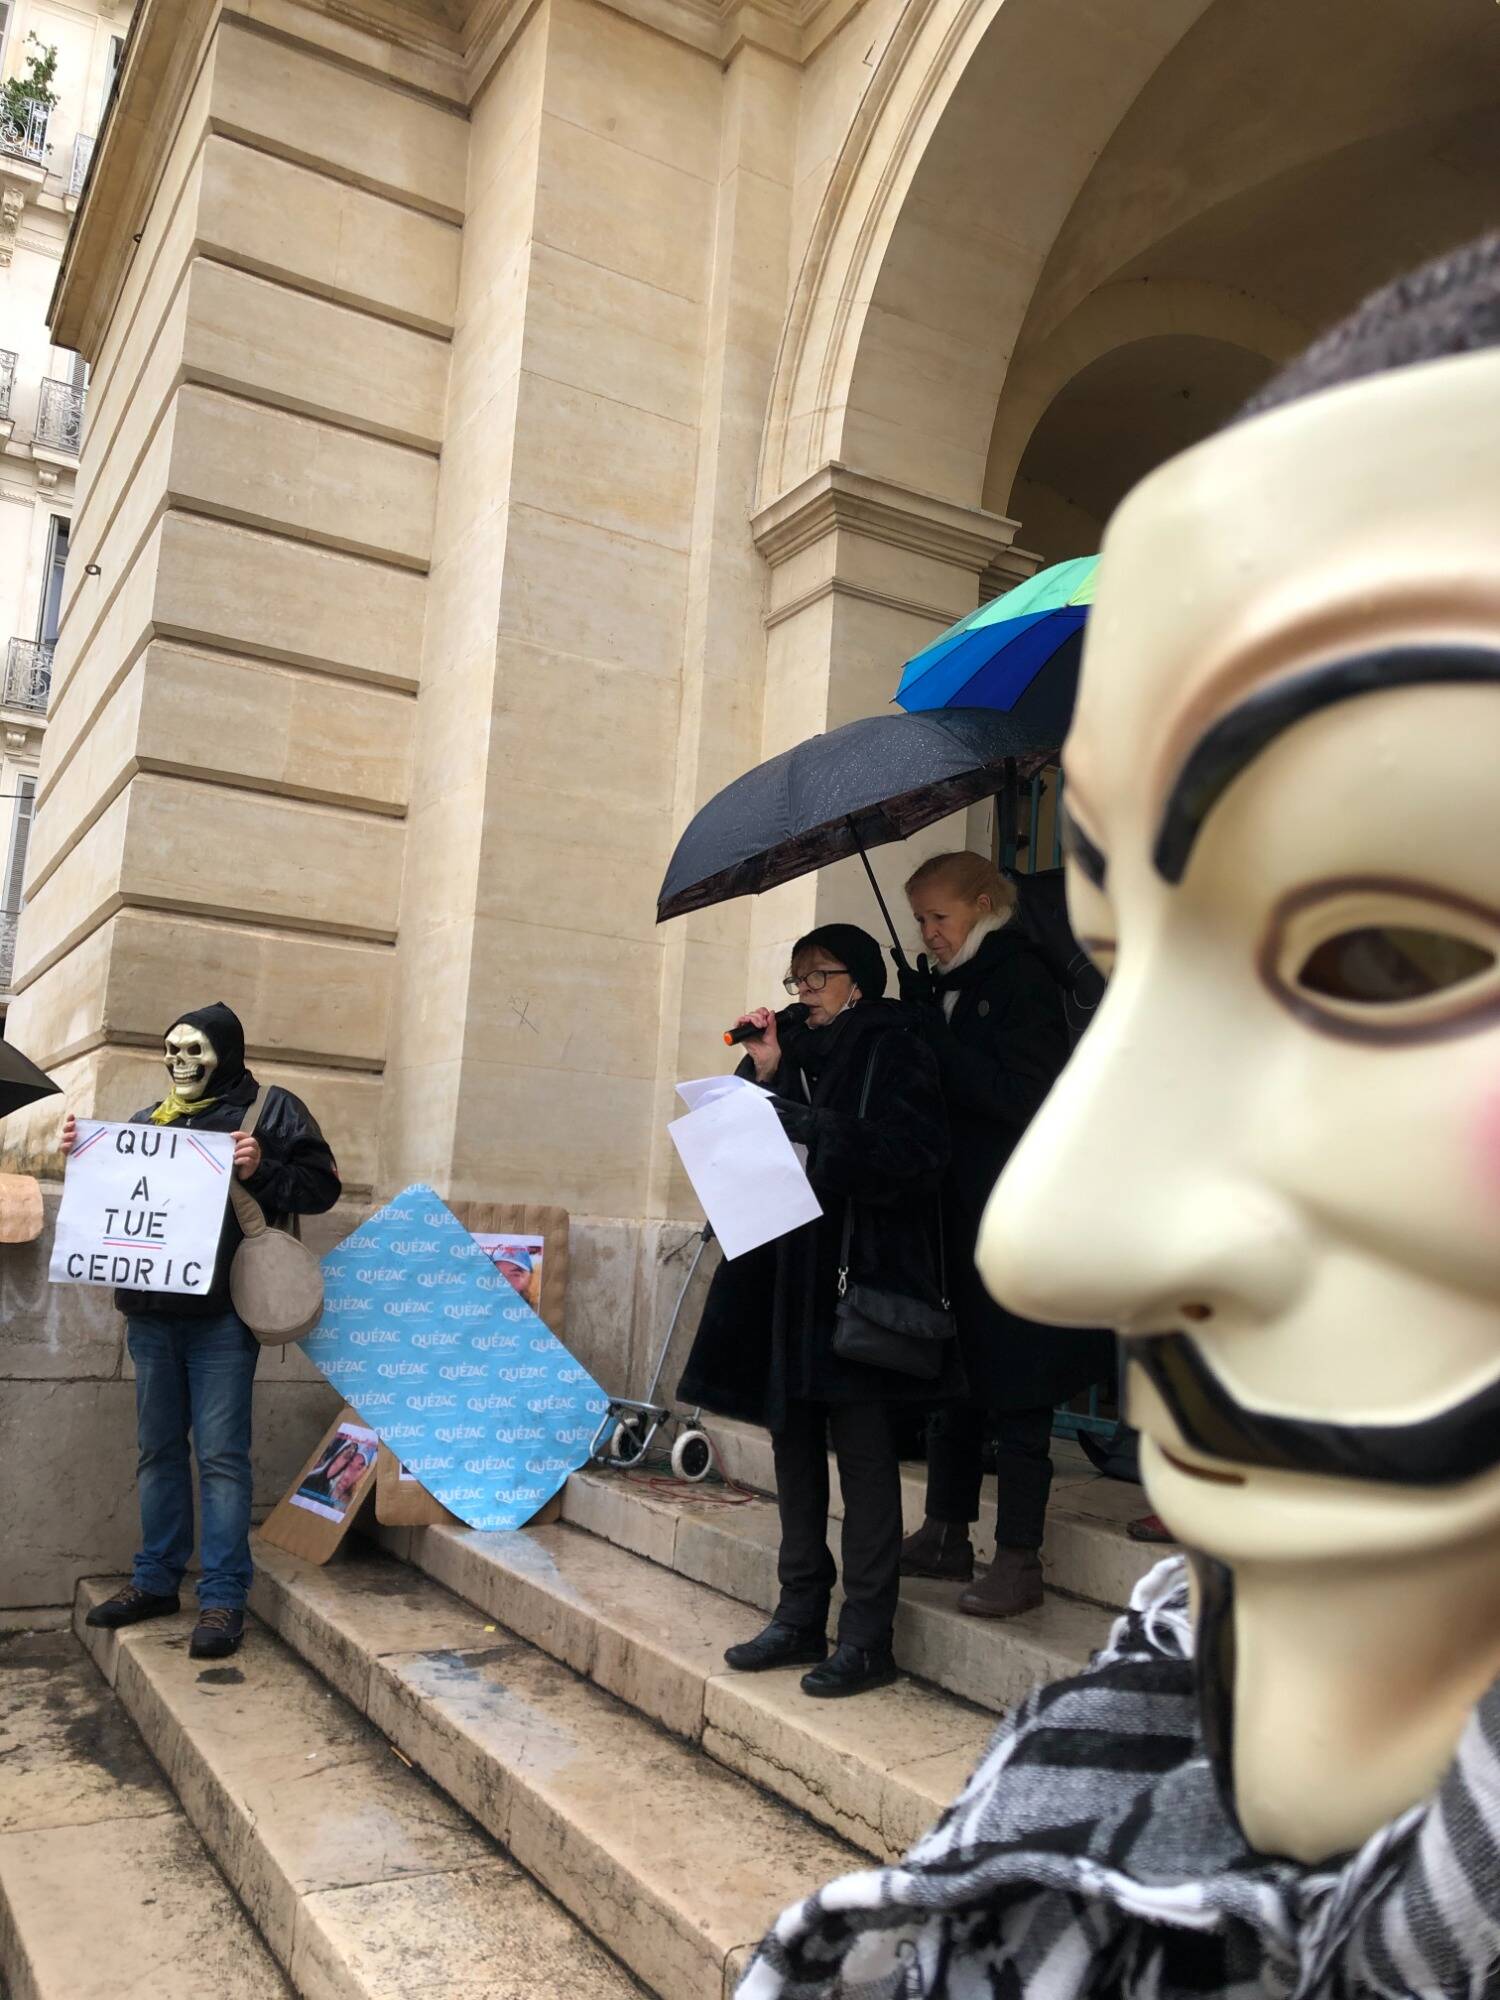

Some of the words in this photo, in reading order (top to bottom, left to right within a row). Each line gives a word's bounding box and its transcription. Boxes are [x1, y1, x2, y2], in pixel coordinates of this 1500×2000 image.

[116, 1129, 177, 1159] QUI
[130, 1176, 149, 1201] A
[390, 1238, 440, 1255] QUÉZAC
[67, 1253, 201, 1287] CEDRIC
[356, 1266, 407, 1284] QUÉZAC
[417, 1270, 466, 1287] QUÉZAC
[383, 1298, 433, 1316] QUÉZAC
[444, 1301, 493, 1318] QUÉZAC
[349, 1326, 400, 1345] QUÉZAC
[411, 1329, 461, 1348] QUÉZAC
[471, 1332, 520, 1349] QUÉZAC
[377, 1360, 428, 1378] QUÉZAC
[439, 1362, 488, 1380] QUÉZAC
[499, 1363, 547, 1382] QUÉZAC
[406, 1392, 456, 1411] QUÉZAC
[466, 1394, 516, 1411] QUÉZAC
[527, 1395, 576, 1413] QUÉZAC
[373, 1422, 425, 1441] QUÉZAC
[435, 1424, 485, 1443] QUÉZAC
[496, 1425, 545, 1443] QUÉZAC
[404, 1454, 453, 1473] QUÉZAC
[464, 1456, 515, 1474] QUÉZAC
[525, 1458, 575, 1474] QUÉZAC
[433, 1485, 484, 1504] QUÉZAC
[495, 1487, 545, 1504] QUÉZAC
